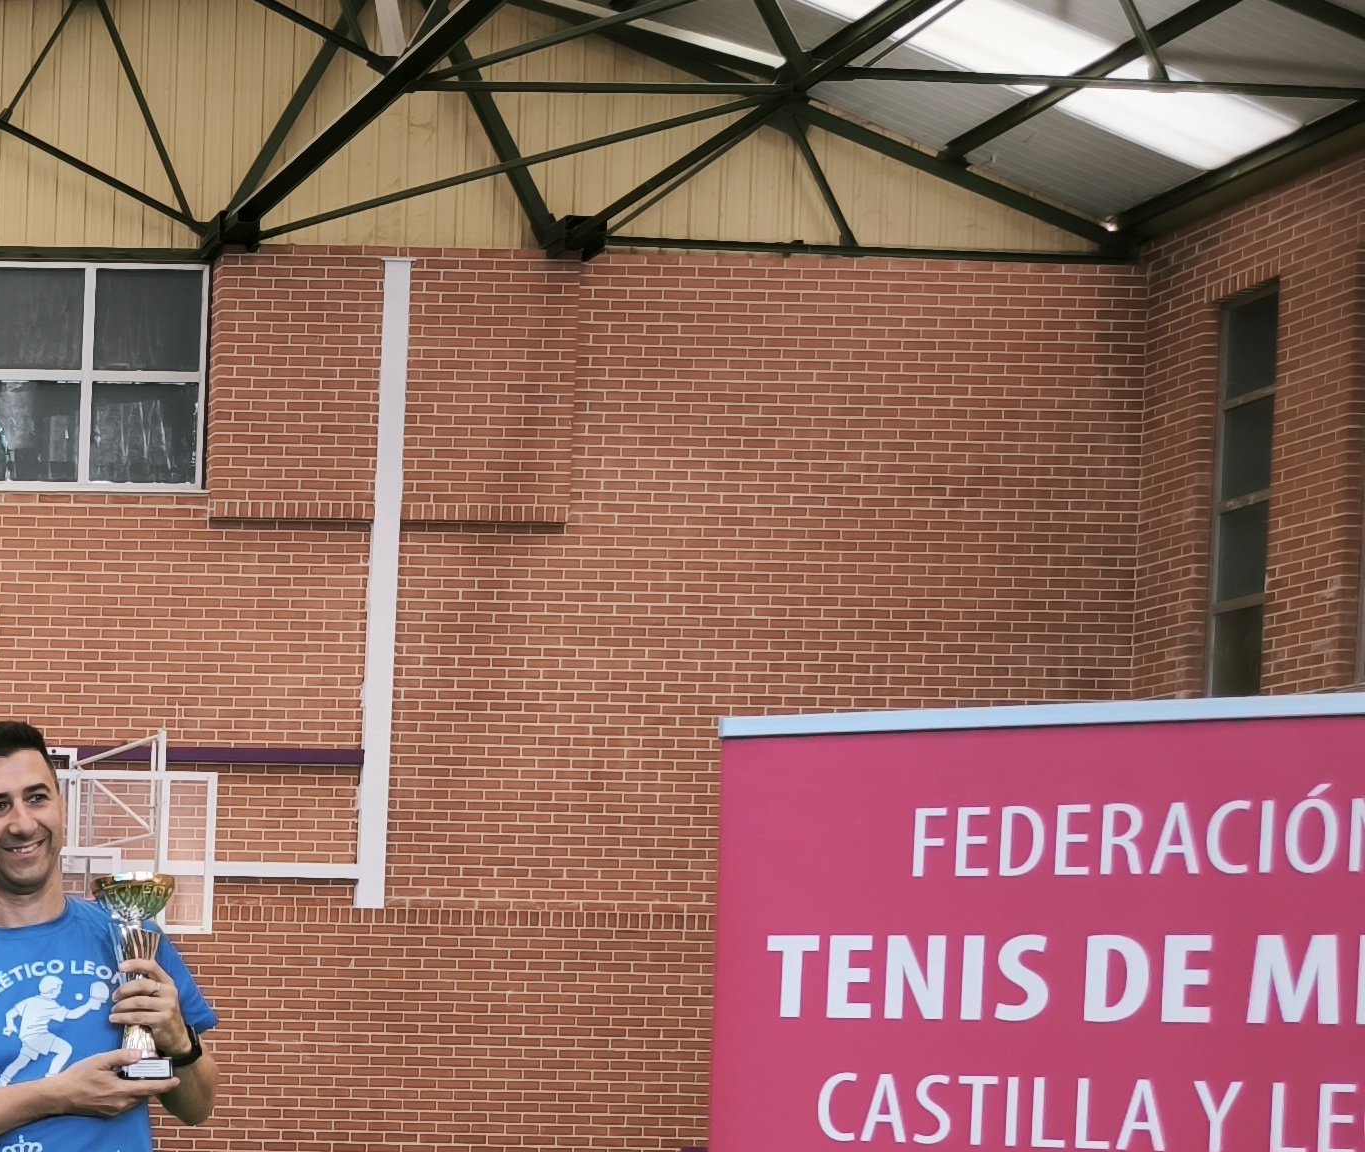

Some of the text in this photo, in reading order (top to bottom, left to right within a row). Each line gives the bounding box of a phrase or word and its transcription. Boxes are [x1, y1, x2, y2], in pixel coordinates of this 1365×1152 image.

[766, 934, 1365, 1025] TENIS DE M
[817, 1071, 1165, 1152] CASTILLA
